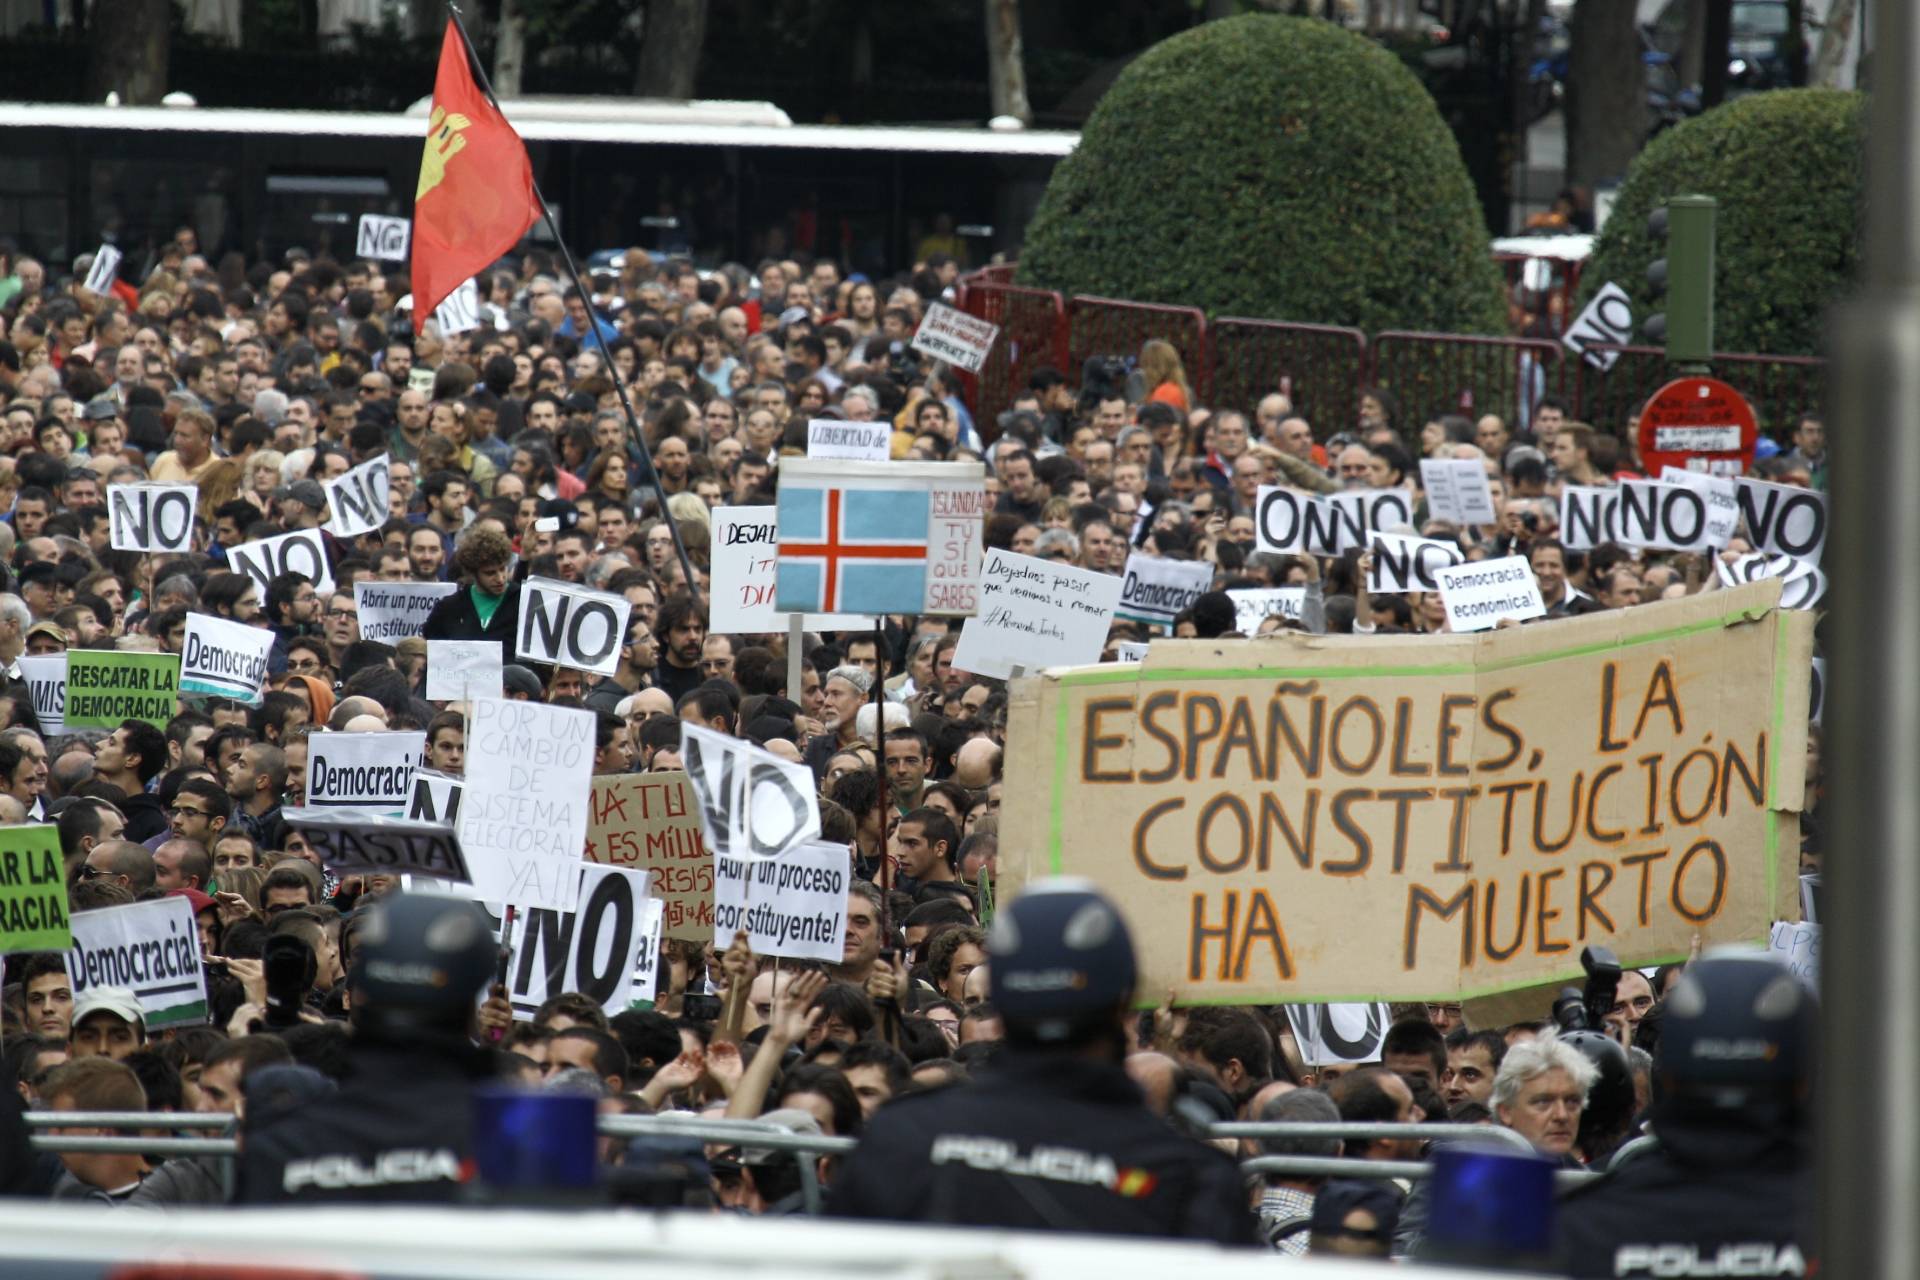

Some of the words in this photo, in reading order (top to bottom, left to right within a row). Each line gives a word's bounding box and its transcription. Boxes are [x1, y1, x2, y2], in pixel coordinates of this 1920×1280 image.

[811, 426, 872, 447] LIBERTAD
[873, 430, 887, 448] de
[332, 462, 389, 531] NO
[1621, 484, 1706, 546] NO
[112, 489, 191, 549] NO
[235, 536, 324, 588] NO
[933, 562, 969, 579] QUE
[1372, 536, 1458, 590] NO
[1444, 565, 1527, 590] Democracia
[360, 589, 390, 609] Abrir
[391, 594, 406, 609] un
[928, 584, 976, 610] SABES
[983, 581, 1003, 595] que
[522, 589, 618, 667] NO
[69, 665, 150, 689] RESCATAR
[153, 669, 173, 692] LA
[71, 696, 174, 719] DEMOCRACIA.
[476, 702, 536, 736] POR
[552, 712, 593, 742] UN
[1080, 678, 1545, 784] ESPAÑOLES,
[1597, 658, 1685, 753] LA
[480, 732, 582, 768] CAMBIO
[509, 767, 544, 793] DE
[468, 790, 571, 828] SISTEMA
[633, 783, 686, 819] TU
[1132, 730, 1767, 882] CONSTITUCIÓN
[461, 821, 580, 858] ELECTORAL
[607, 831, 639, 864] ES
[26, 849, 59, 884] LA
[758, 861, 776, 885] un
[777, 862, 842, 895] proceso
[1188, 886, 1297, 981] HA
[1403, 836, 1728, 970] MUERTO
[69, 917, 199, 993] Democracia!
[514, 872, 633, 1008] NO
[281, 1148, 458, 1194] POLICIA
[930, 1131, 1119, 1190] POLICIA
[1614, 1243, 1806, 1277] POLICIA
